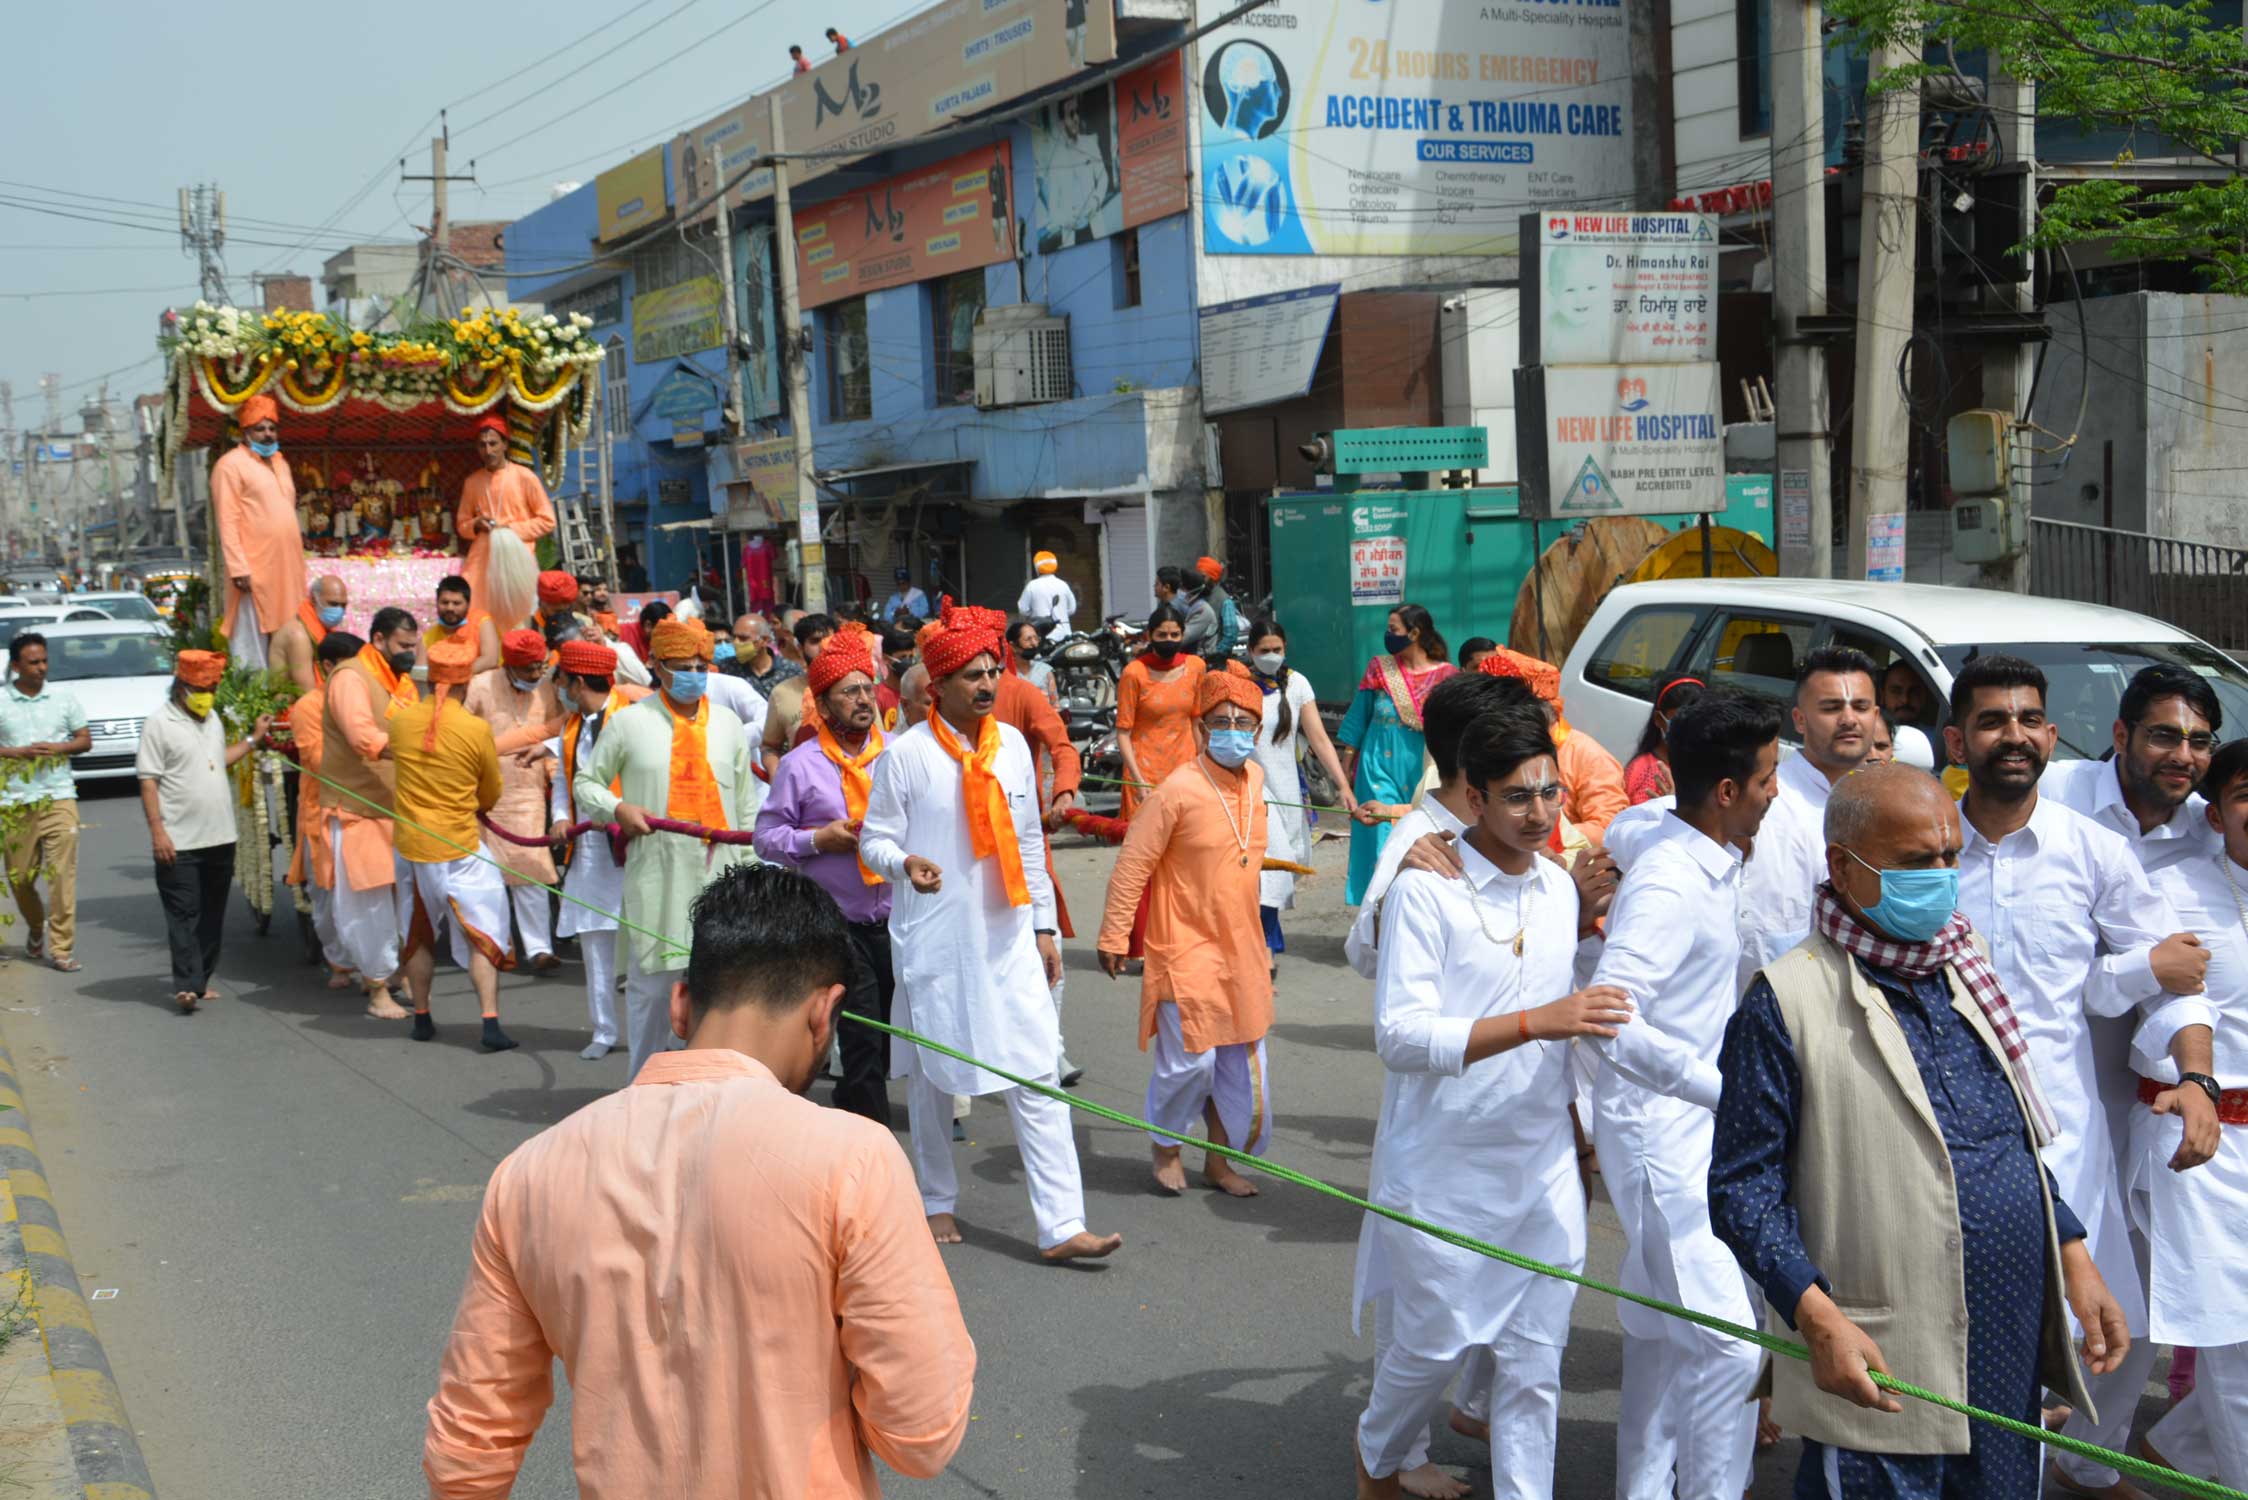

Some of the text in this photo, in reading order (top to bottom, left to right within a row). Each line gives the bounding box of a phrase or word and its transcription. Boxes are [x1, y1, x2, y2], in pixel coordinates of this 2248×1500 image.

[1245, 13, 1297, 29] ACCREDITED
[1480, 8, 1489, 20] A
[1578, 15, 1623, 28] Hospital
[1349, 36, 1599, 85] 24 HOURS EMERGENCY
[1326, 94, 1622, 136] ACCIDENT & TRAUMA CARE
[849, 120, 896, 150] STUDIO
[1423, 143, 1531, 161] OUR SERVICES
[1435, 171, 1506, 184] Chemotherapy
[1528, 172, 1574, 183] ENT Care
[1574, 217, 1690, 234] NEW LIFE HOSPITAL
[1606, 254, 1709, 269] Dr. Himanshu Rai
[1557, 414, 1717, 443] NEW LIFE HOSPITAL
[1610, 466, 1715, 479] NABH PRE ENTRY LEVEL
[1635, 480, 1692, 492] ACCREDITED
